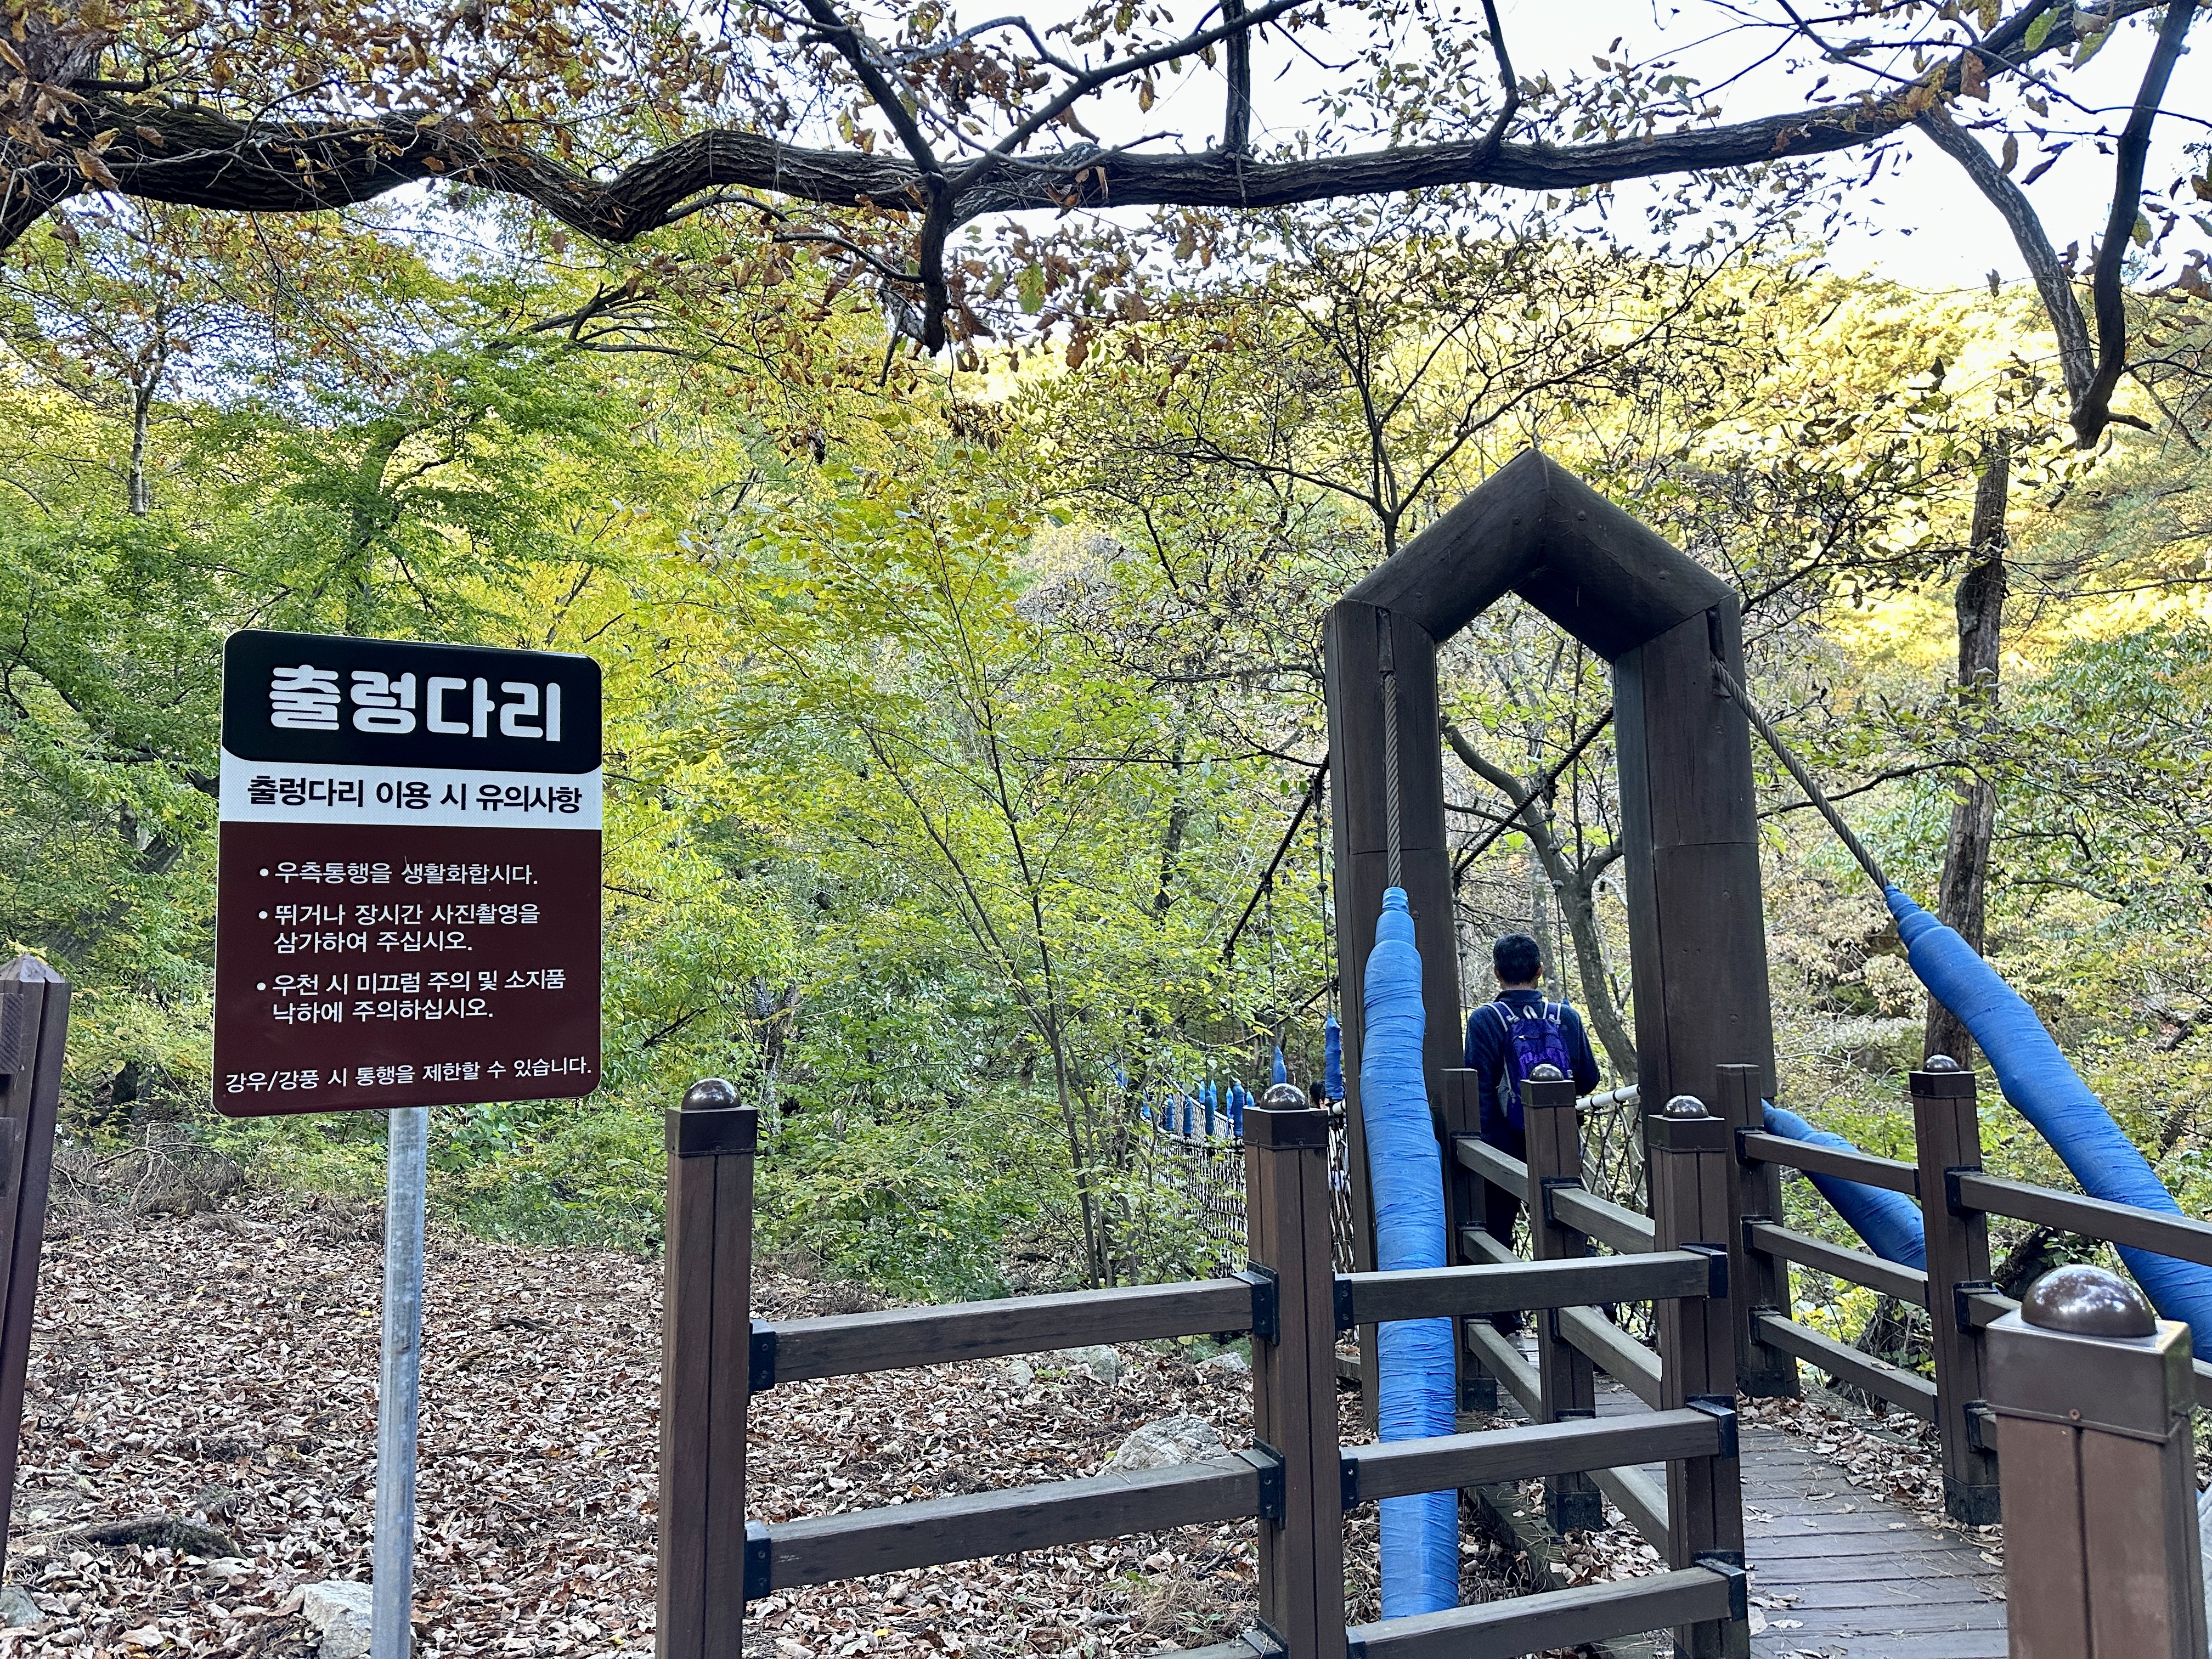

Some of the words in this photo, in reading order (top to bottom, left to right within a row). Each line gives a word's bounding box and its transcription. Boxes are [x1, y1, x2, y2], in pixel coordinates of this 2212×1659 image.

[269, 664, 561, 742] 출렁다리
[247, 775, 364, 808] 출렁다리
[376, 781, 431, 810] 이용
[439, 783, 466, 810] 시
[476, 784, 583, 814] 유의사항
[275, 861, 392, 884] 우측통행을
[400, 862, 538, 885] 생활화합시다.
[274, 904, 346, 926] 뛰거나
[354, 904, 424, 926] 장시간
[431, 904, 540, 924] 사진촬영을
[273, 931, 366, 954] 삼가하여
[376, 930, 472, 952] 주십시오.
[272, 974, 318, 997] 우천
[325, 973, 348, 995] 시
[357, 972, 420, 994] 미끄럼
[427, 970, 470, 992] 주의
[478, 970, 497, 991] 및
[504, 969, 566, 990] 소지품
[273, 1001, 342, 1025] 낙하에
[352, 997, 493, 1022] 주의하십시오.
[225, 1070, 320, 1093] 강우/강풍
[328, 1068, 347, 1087] 시
[355, 1065, 415, 1086] 통행을
[422, 1062, 481, 1082] 제한할
[487, 1060, 506, 1079] 수
[514, 1056, 591, 1077] 있습니다.
